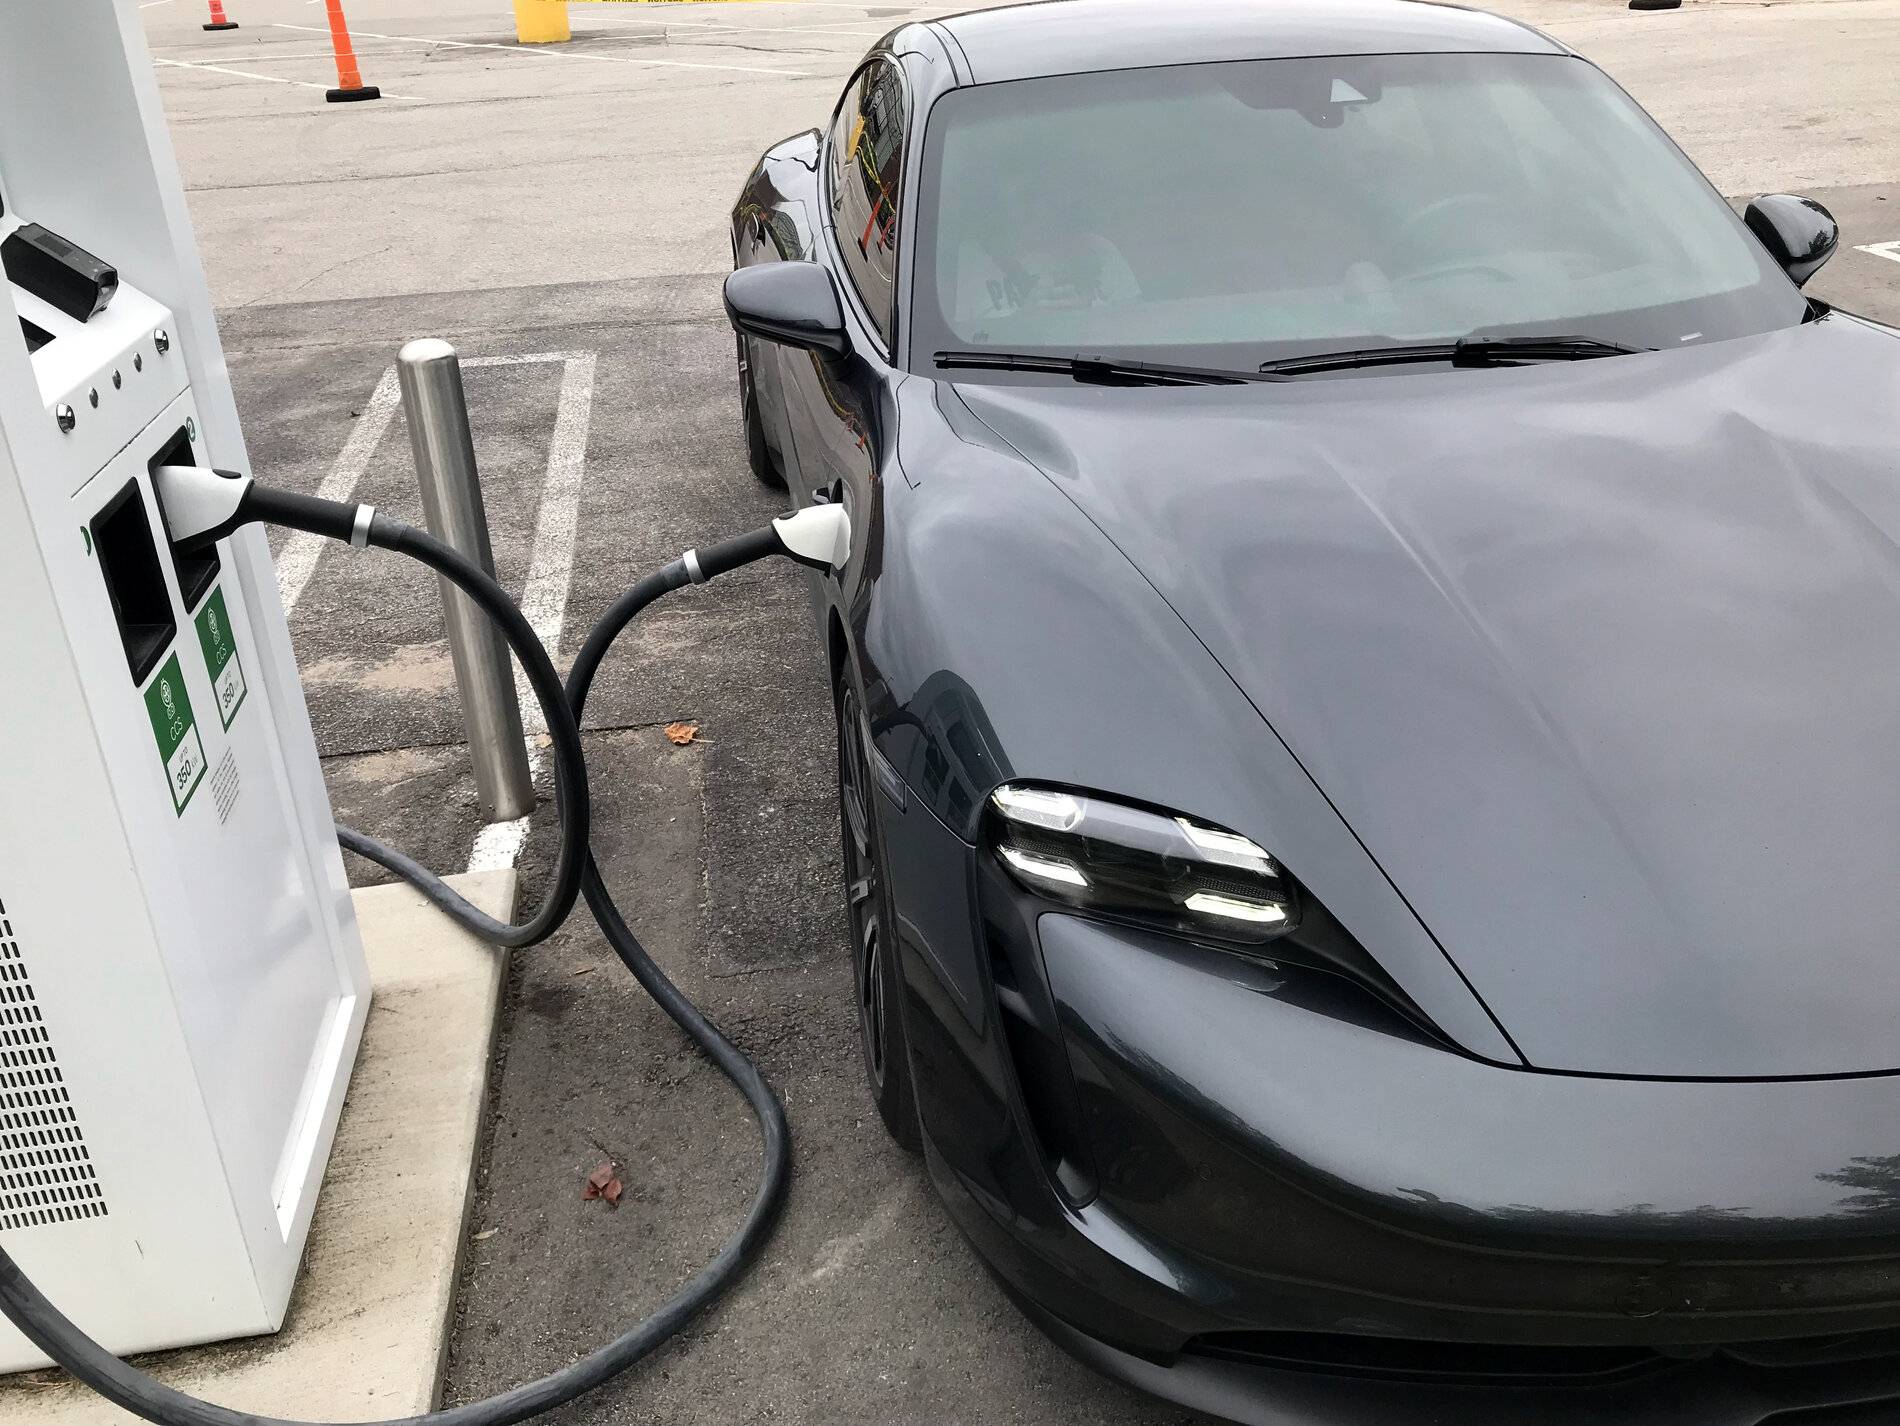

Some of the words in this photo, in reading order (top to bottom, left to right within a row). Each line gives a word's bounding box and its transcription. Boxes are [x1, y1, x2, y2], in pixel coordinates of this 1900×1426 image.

[216, 643, 227, 665] CCS
[222, 682, 235, 709] 350
[170, 716, 183, 741] CCS
[176, 760, 192, 790] 350
